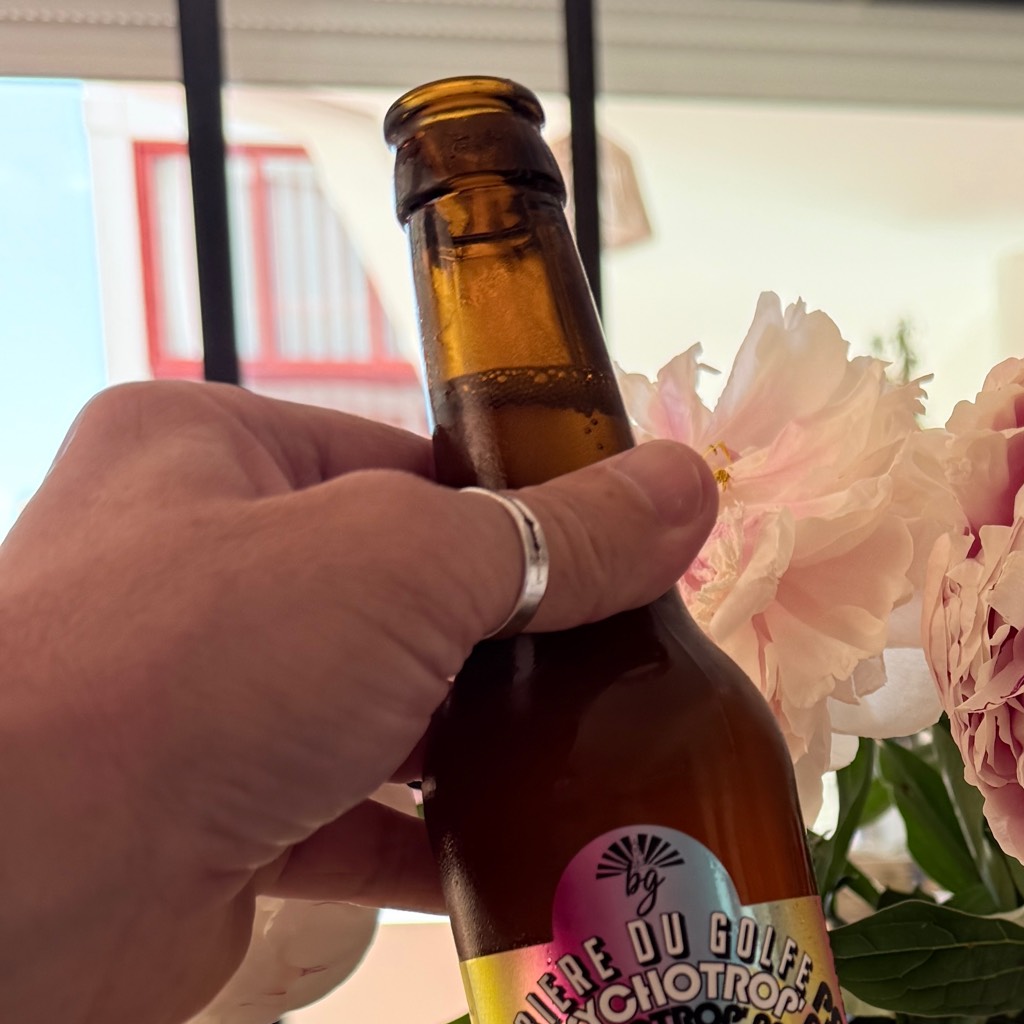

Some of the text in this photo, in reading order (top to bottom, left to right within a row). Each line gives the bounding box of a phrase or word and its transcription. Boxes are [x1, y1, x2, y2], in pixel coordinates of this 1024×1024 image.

[624, 860, 666, 916] bg
[626, 911, 690, 966] DU
[710, 911, 814, 988] GOLFE
